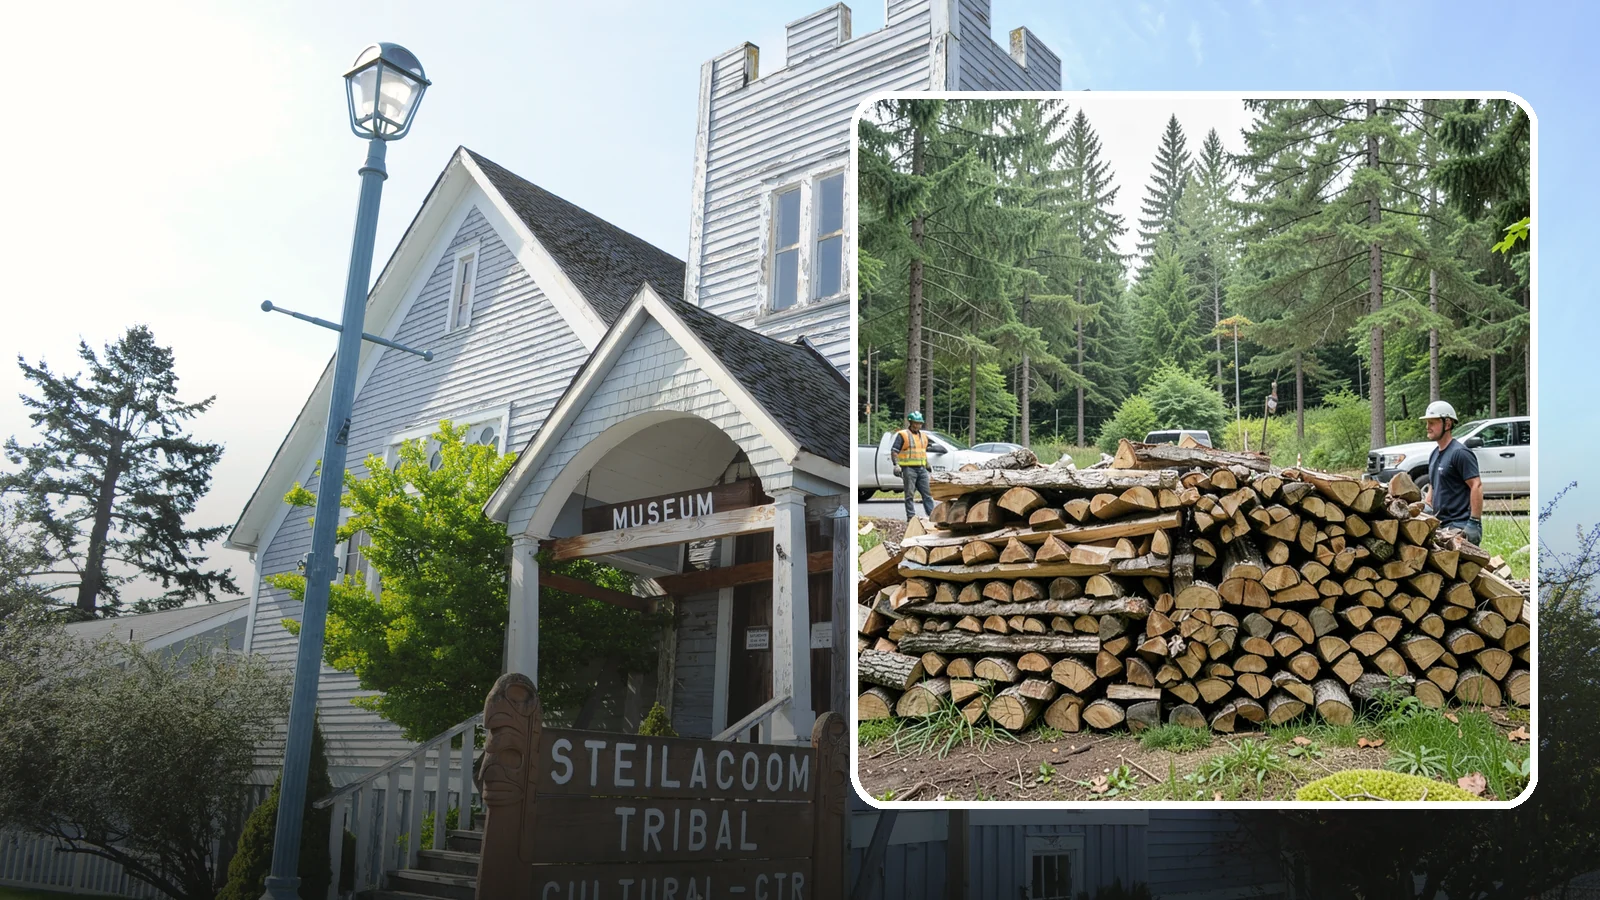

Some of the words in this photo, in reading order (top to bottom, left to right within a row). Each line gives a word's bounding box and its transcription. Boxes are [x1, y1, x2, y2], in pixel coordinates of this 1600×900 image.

[613, 491, 714, 531] MUSEUM
[550, 738, 810, 792] STEILACOOM
[614, 807, 758, 852] TRIBAL
